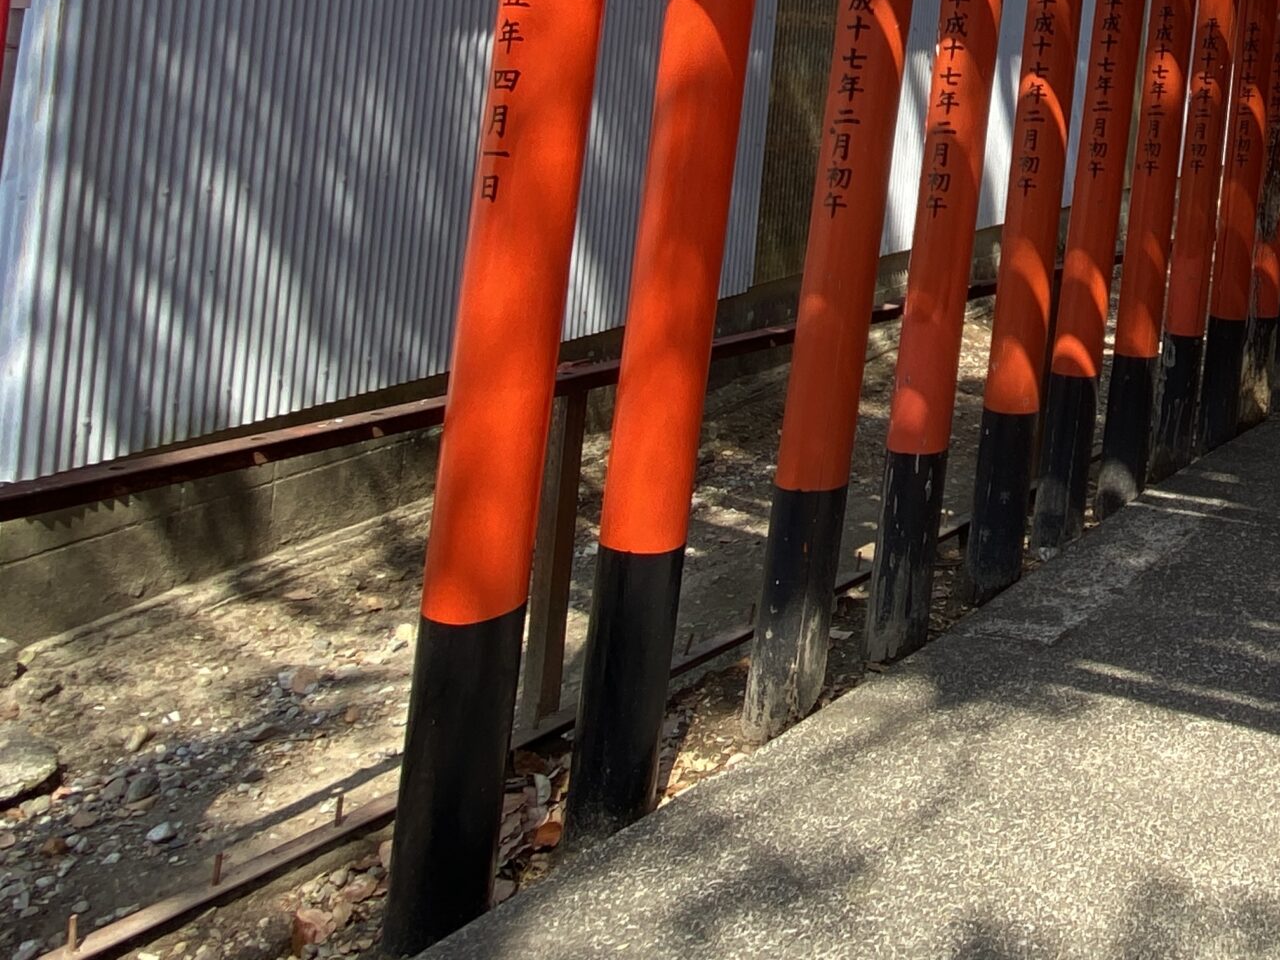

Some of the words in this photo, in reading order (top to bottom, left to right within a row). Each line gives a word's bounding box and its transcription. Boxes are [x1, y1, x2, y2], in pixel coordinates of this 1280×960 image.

[1143, 5, 1176, 176] 平成十七年二月初午
